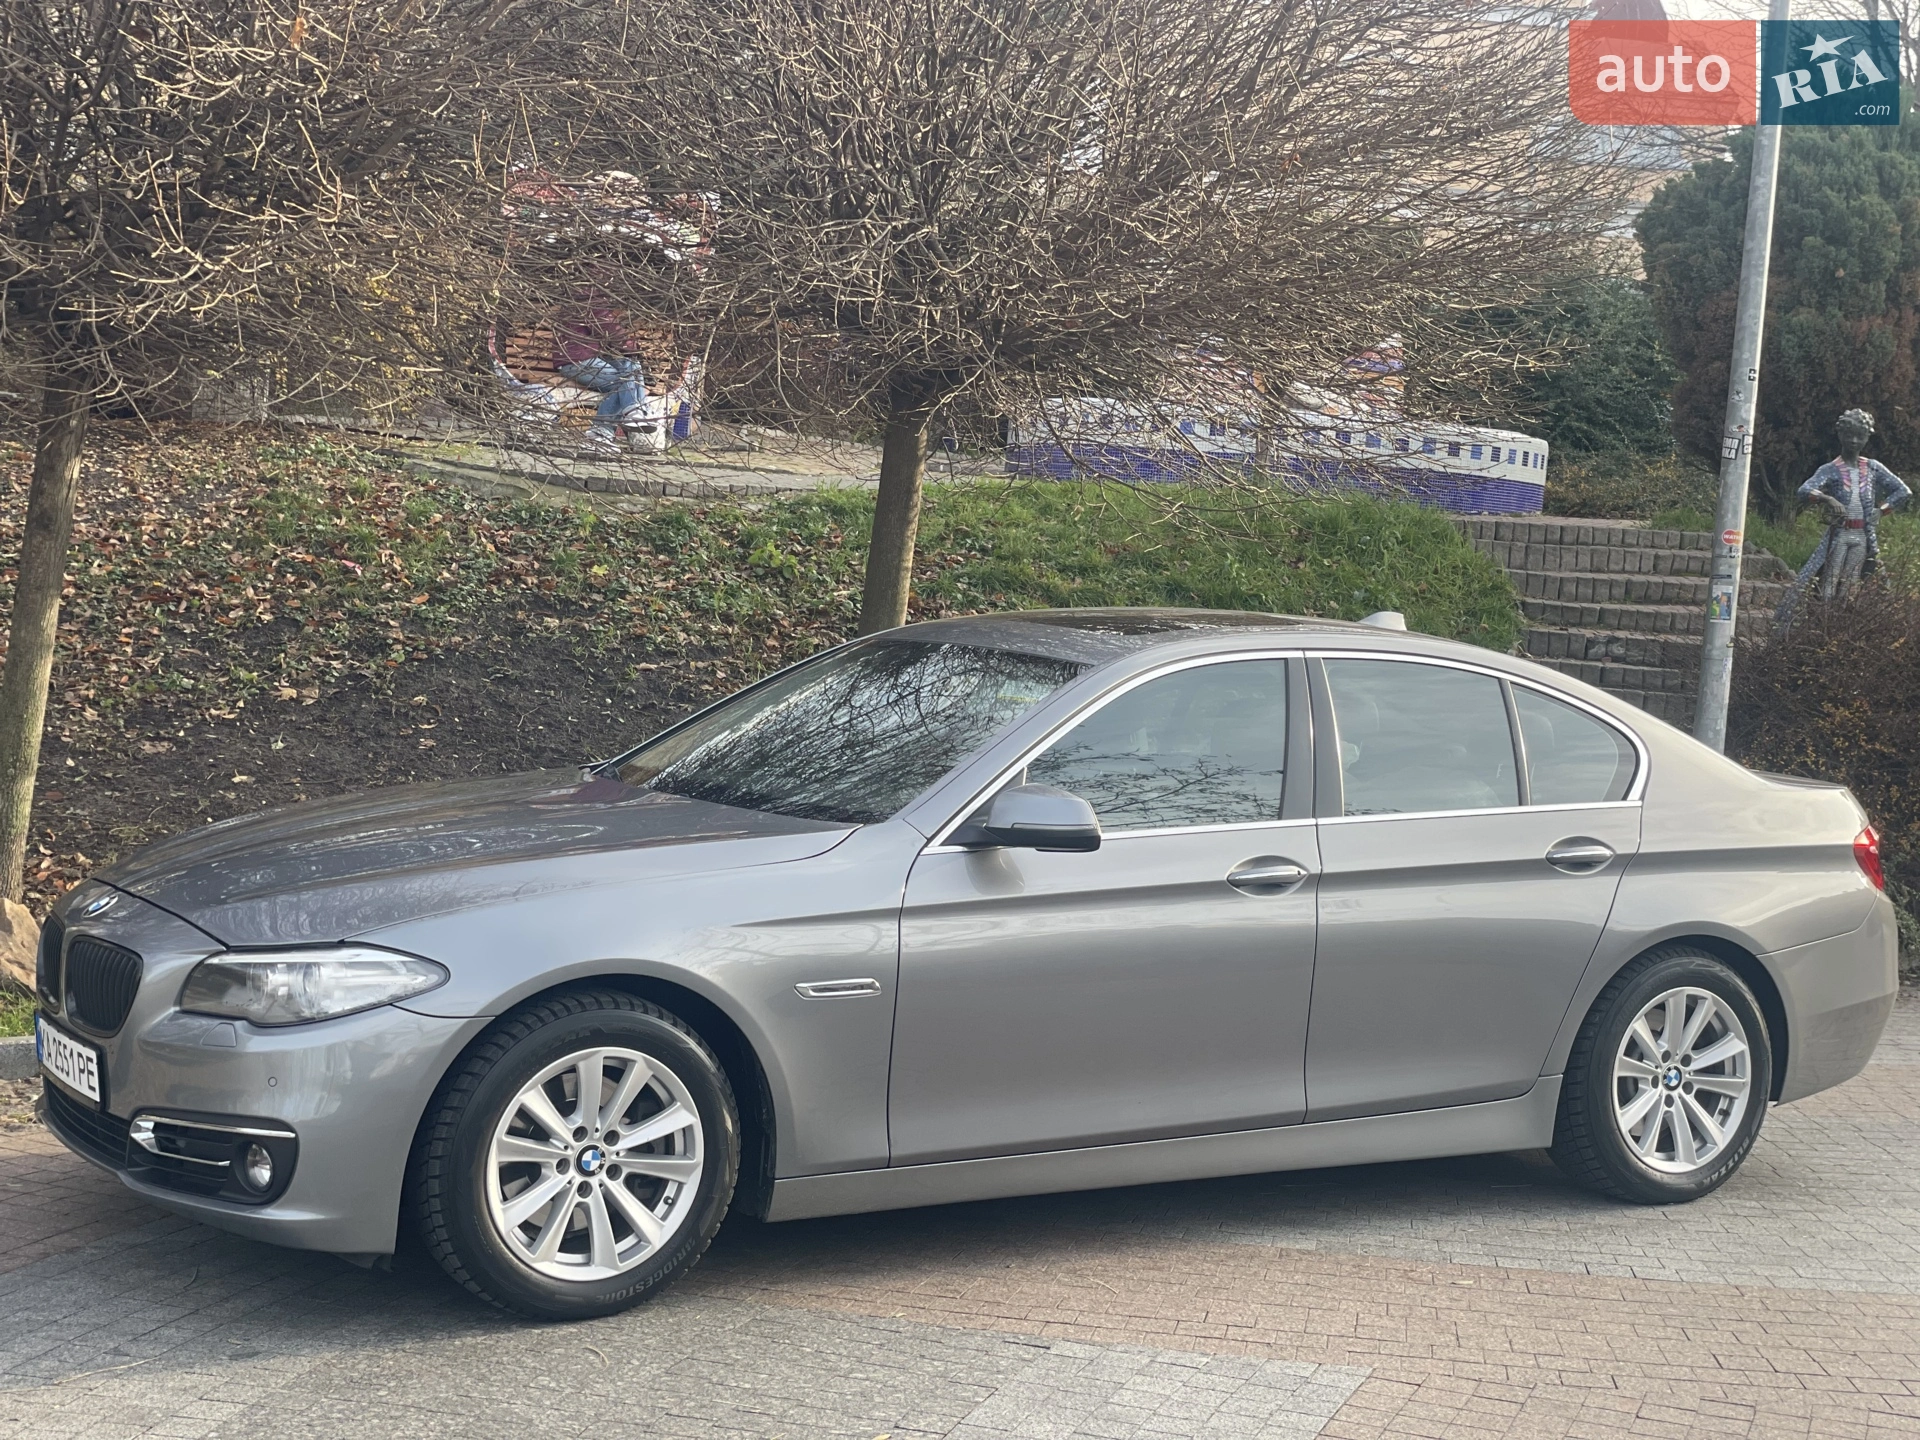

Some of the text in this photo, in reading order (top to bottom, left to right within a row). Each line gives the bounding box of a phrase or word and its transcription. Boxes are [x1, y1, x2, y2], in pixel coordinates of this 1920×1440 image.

[53, 1036, 76, 1082] 2551
[77, 1051, 97, 1093] PE
[1702, 1136, 1750, 1187] BLIZZAK
[596, 1236, 696, 1303] BRIDGESTONE
